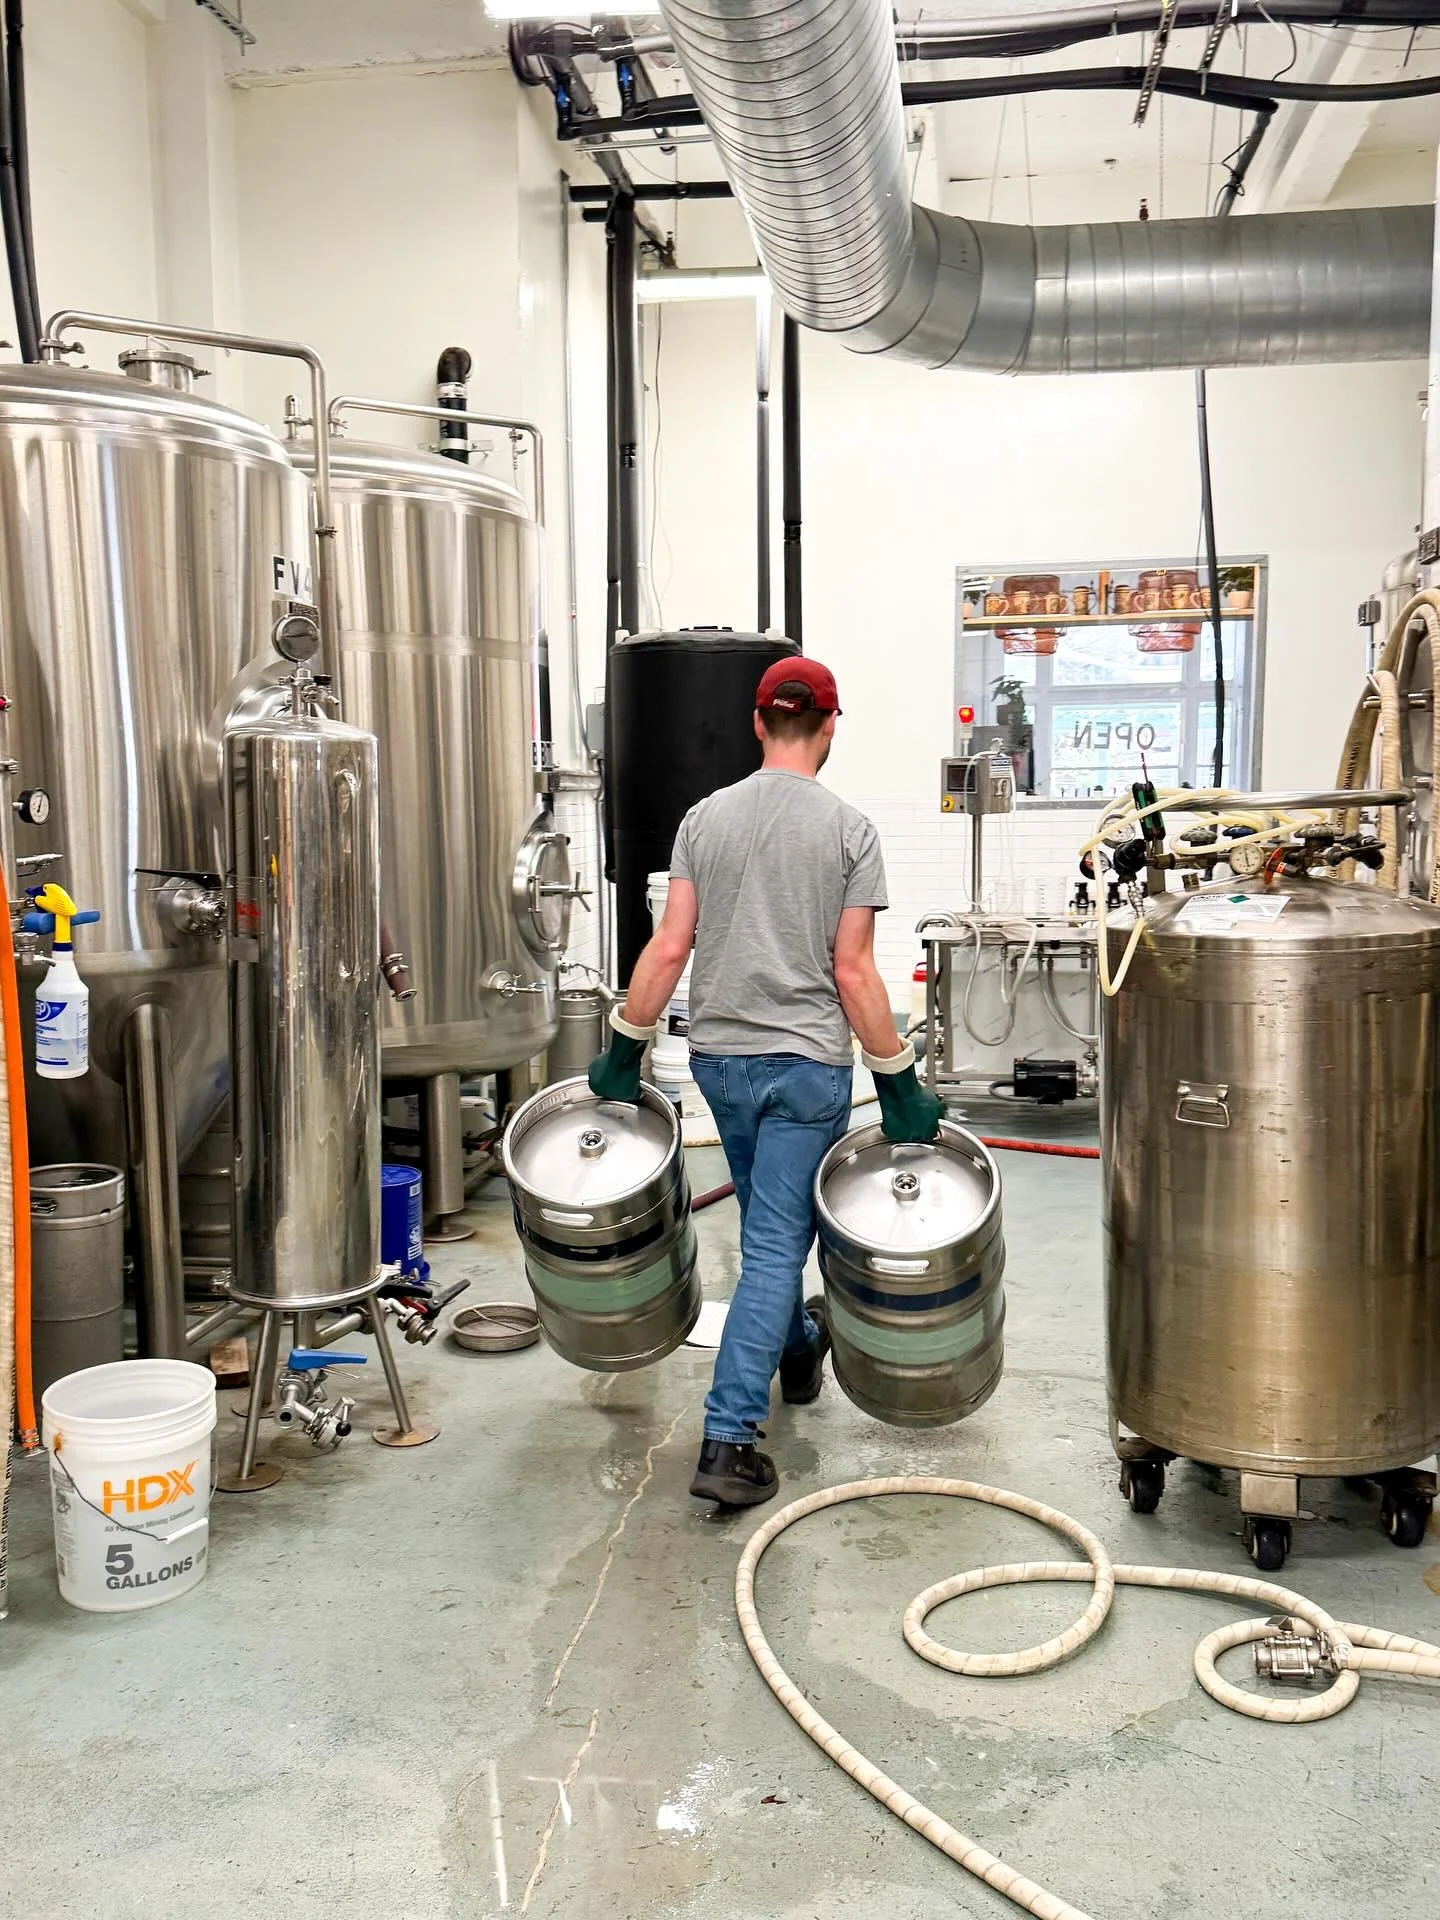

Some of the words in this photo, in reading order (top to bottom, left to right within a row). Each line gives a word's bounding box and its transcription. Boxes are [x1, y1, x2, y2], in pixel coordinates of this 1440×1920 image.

[103, 1459, 195, 1514] HDX
[105, 1543, 134, 1576] 5
[106, 1556, 193, 1590] GALLONS
